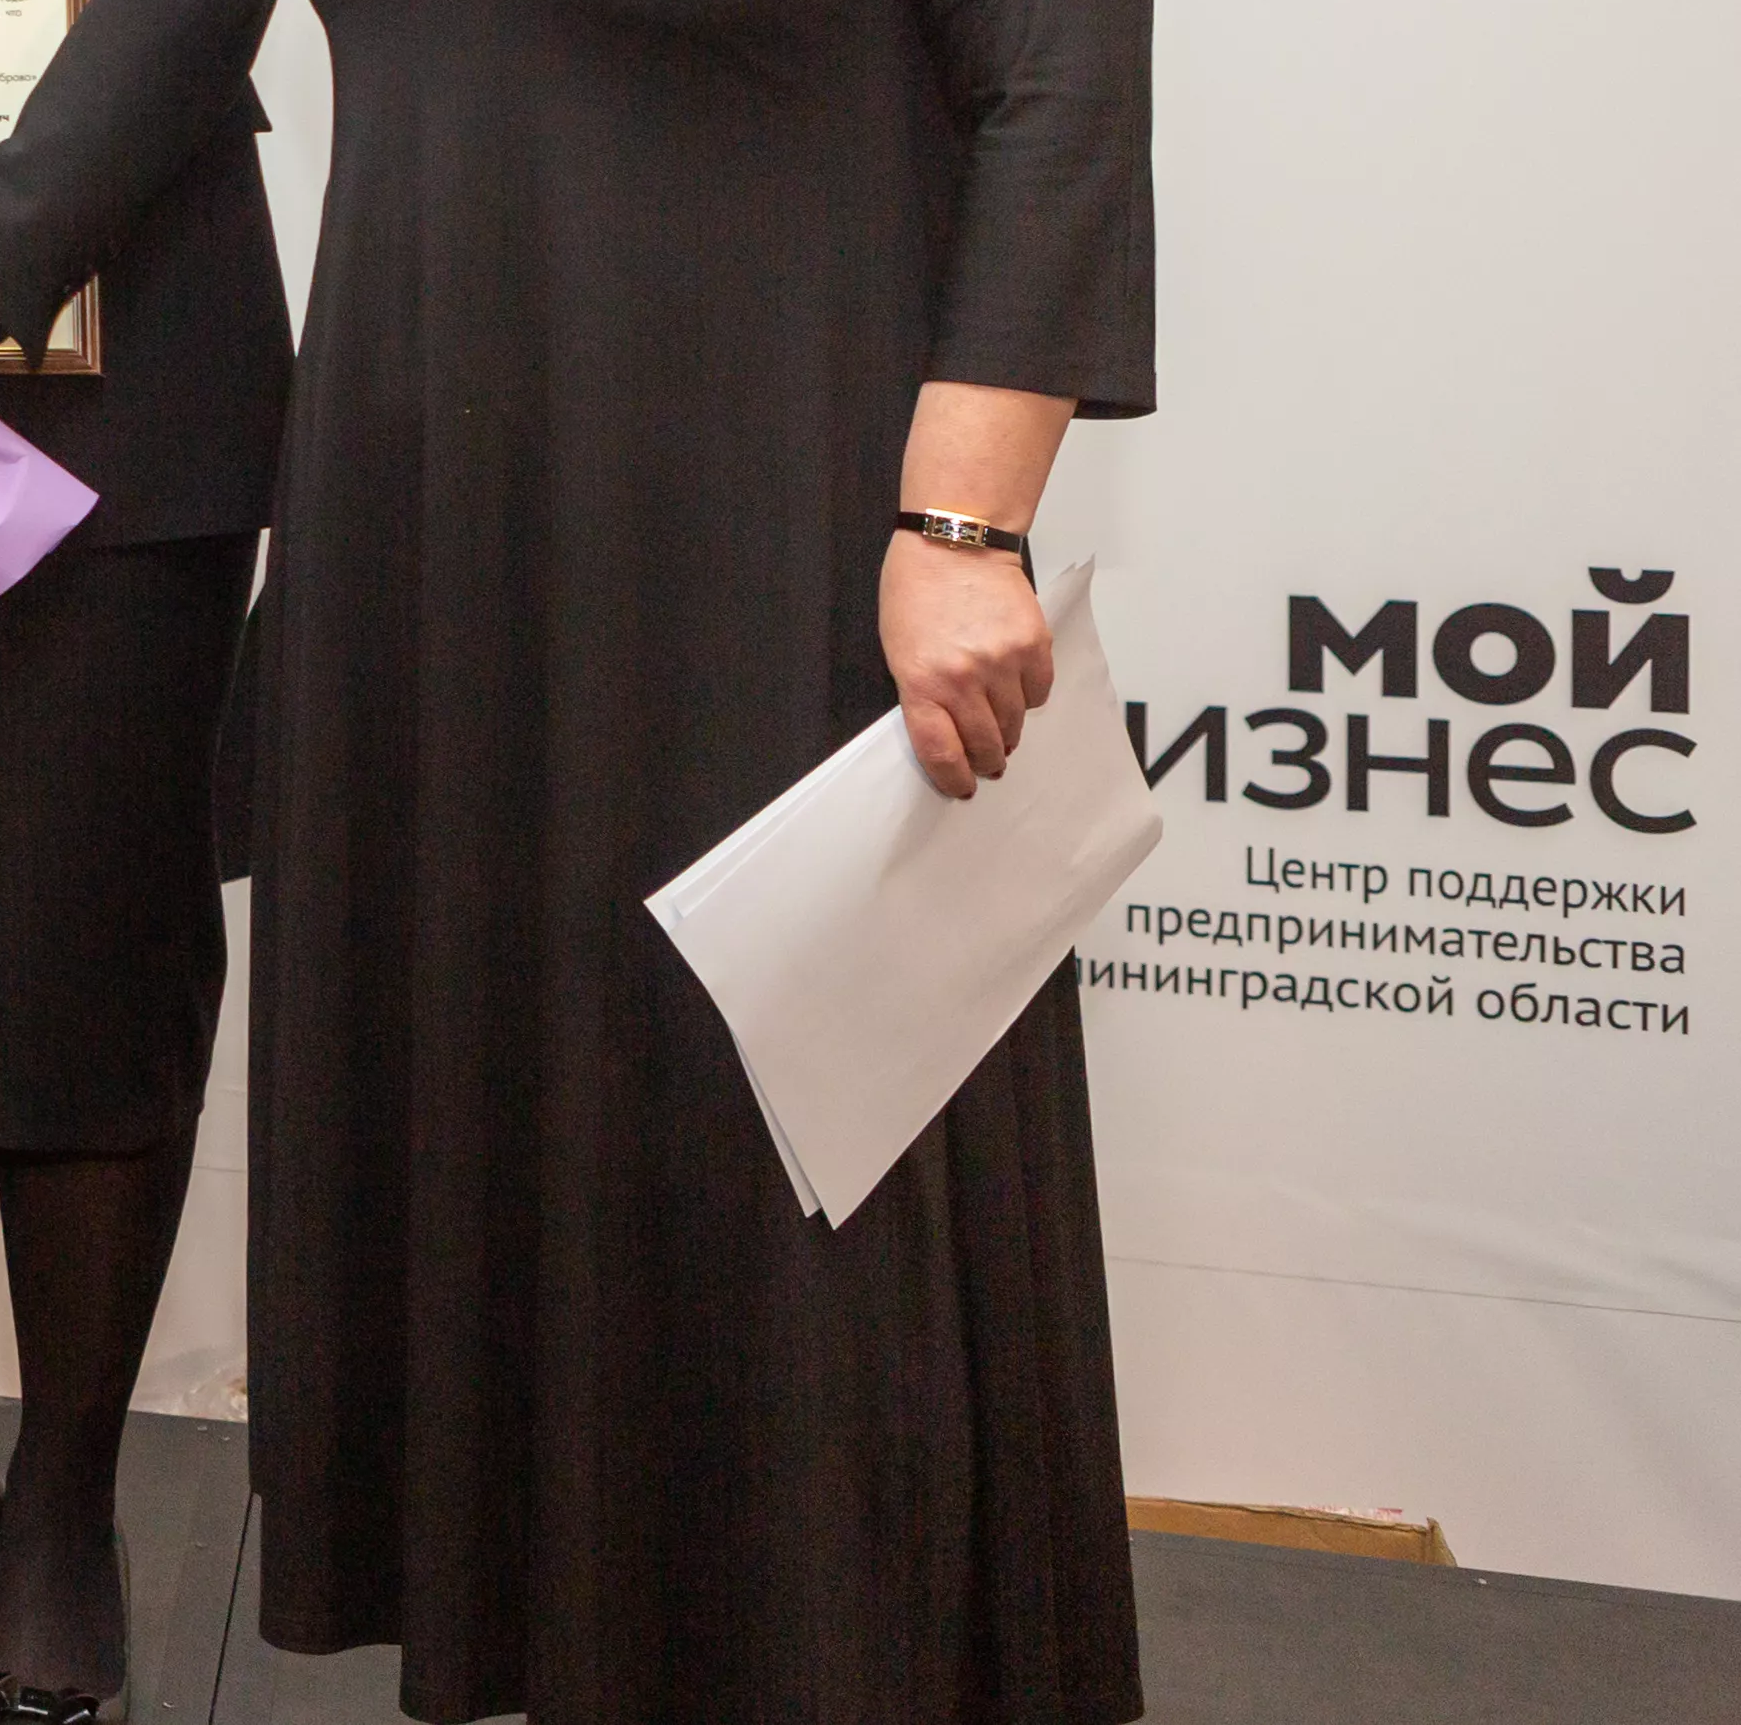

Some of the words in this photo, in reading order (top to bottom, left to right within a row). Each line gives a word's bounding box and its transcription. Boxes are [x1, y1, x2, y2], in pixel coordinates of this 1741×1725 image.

[1288, 566, 1690, 714] мой
[1124, 700, 1698, 836] изнес
[1246, 846, 1388, 902] Центр
[1408, 866, 1687, 919] поддержки
[1127, 904, 1687, 975] предпринимательства
[1074, 954, 1455, 1018] ининградской
[1476, 983, 1690, 1035] области
